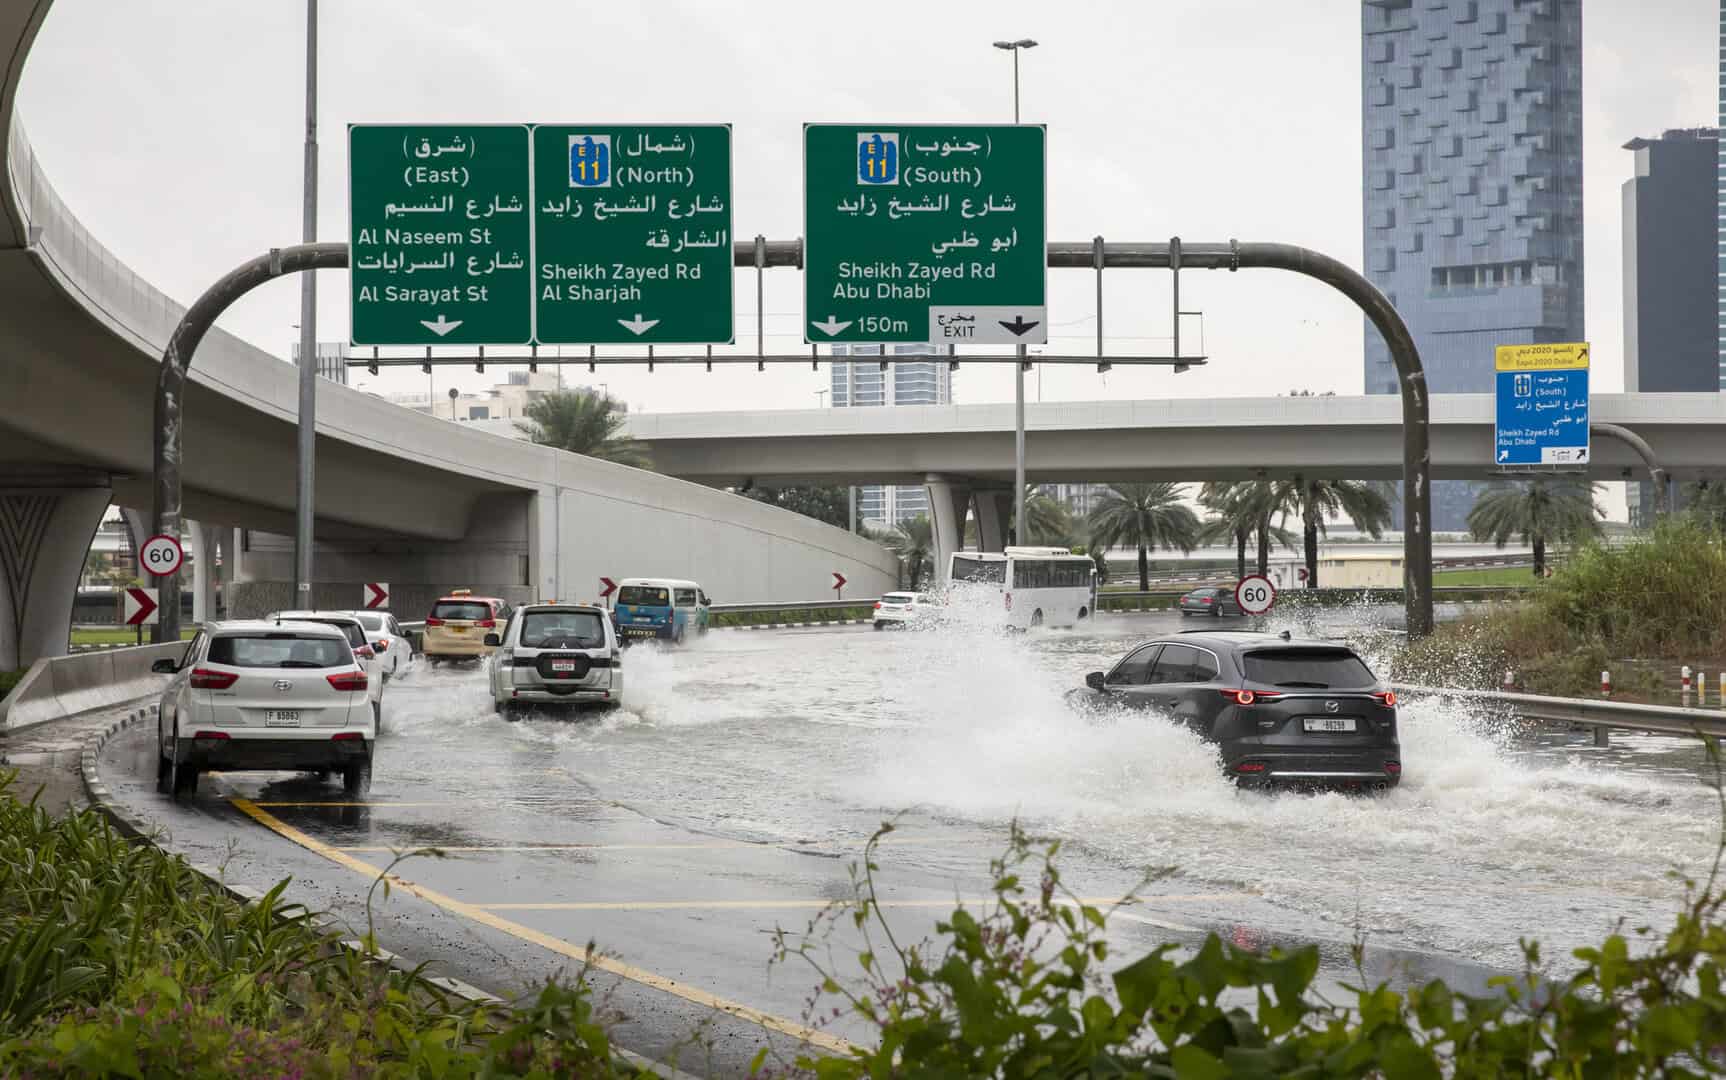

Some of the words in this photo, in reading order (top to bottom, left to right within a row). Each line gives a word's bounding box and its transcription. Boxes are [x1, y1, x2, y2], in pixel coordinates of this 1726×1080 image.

[404, 166, 470, 188] (East)
[577, 160, 600, 180] 11
[616, 166, 694, 188] (North)
[866, 158, 887, 178] 11
[903, 166, 982, 188] (South)
[384, 194, 454, 219] النسيم
[466, 194, 523, 220] شارع
[542, 195, 583, 218] زايد
[593, 194, 656, 221] الشيخ
[668, 194, 724, 220] شارع
[837, 193, 877, 217] زايد
[888, 193, 950, 220] الشيخ
[961, 194, 1017, 219] شارع
[358, 228, 379, 245] Al
[385, 228, 463, 245] Naseem
[469, 228, 492, 245] St
[645, 229, 727, 253] الشارقة
[931, 230, 980, 259] ظبي
[357, 251, 455, 274] السرايات
[466, 252, 524, 276] شارع
[542, 263, 606, 280] Sheikh
[612, 263, 669, 283] Zayed
[676, 263, 701, 280] Rd
[839, 261, 902, 279] Sheikh
[908, 262, 964, 282] Zayed
[971, 262, 996, 279] Rd
[359, 285, 379, 302] Al
[385, 285, 461, 305] Sarayat
[466, 285, 489, 302] St
[542, 285, 562, 301] Al
[568, 285, 641, 304] Sharjah
[832, 282, 870, 299] Abu
[877, 282, 931, 299] Dhabi
[857, 316, 908, 333] 150m
[937, 312, 976, 326] مخرج
[944, 326, 976, 338] EXIT
[1532, 346, 1552, 355] 2020
[1549, 428, 1560, 437] Rd
[150, 548, 174, 564] 60
[1243, 587, 1267, 602] 60
